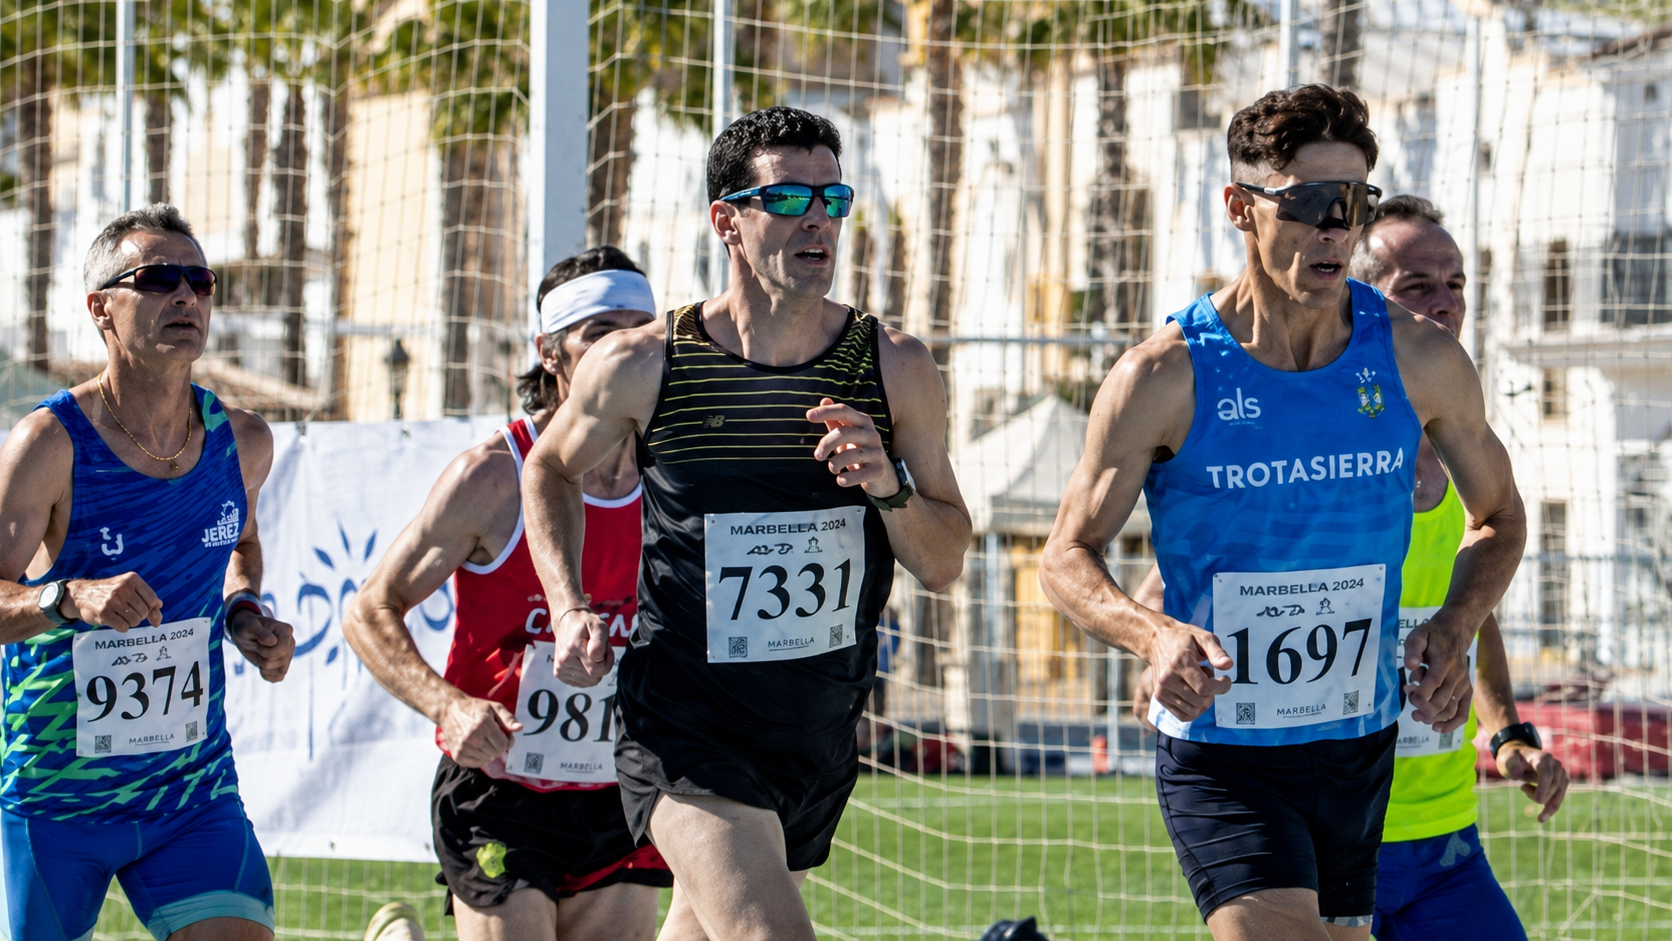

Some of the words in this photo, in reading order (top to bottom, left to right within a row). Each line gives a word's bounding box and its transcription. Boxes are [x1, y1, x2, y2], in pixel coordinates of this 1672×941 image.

[1217, 387, 1262, 420] als
[1206, 447, 1404, 489] TROTASIERRA
[201, 522, 239, 543] JEREZ
[730, 523, 818, 536] MARBELLA
[820, 518, 846, 531] 2024
[718, 558, 851, 621] 7331
[1239, 582, 1329, 596] MARBELLA
[1332, 577, 1364, 591] 2024
[95, 633, 168, 650] MARBELLA
[169, 628, 194, 641] 2024
[767, 637, 815, 648] MARBELLA
[1226, 617, 1373, 685] 1697
[86, 660, 204, 723] 9374
[522, 688, 616, 743] 981
[1276, 703, 1327, 716] MARBELLA
[128, 733, 175, 744] MARBELLA
[1397, 735, 1430, 745] ARBELLA
[559, 761, 603, 771] MARBELLA
